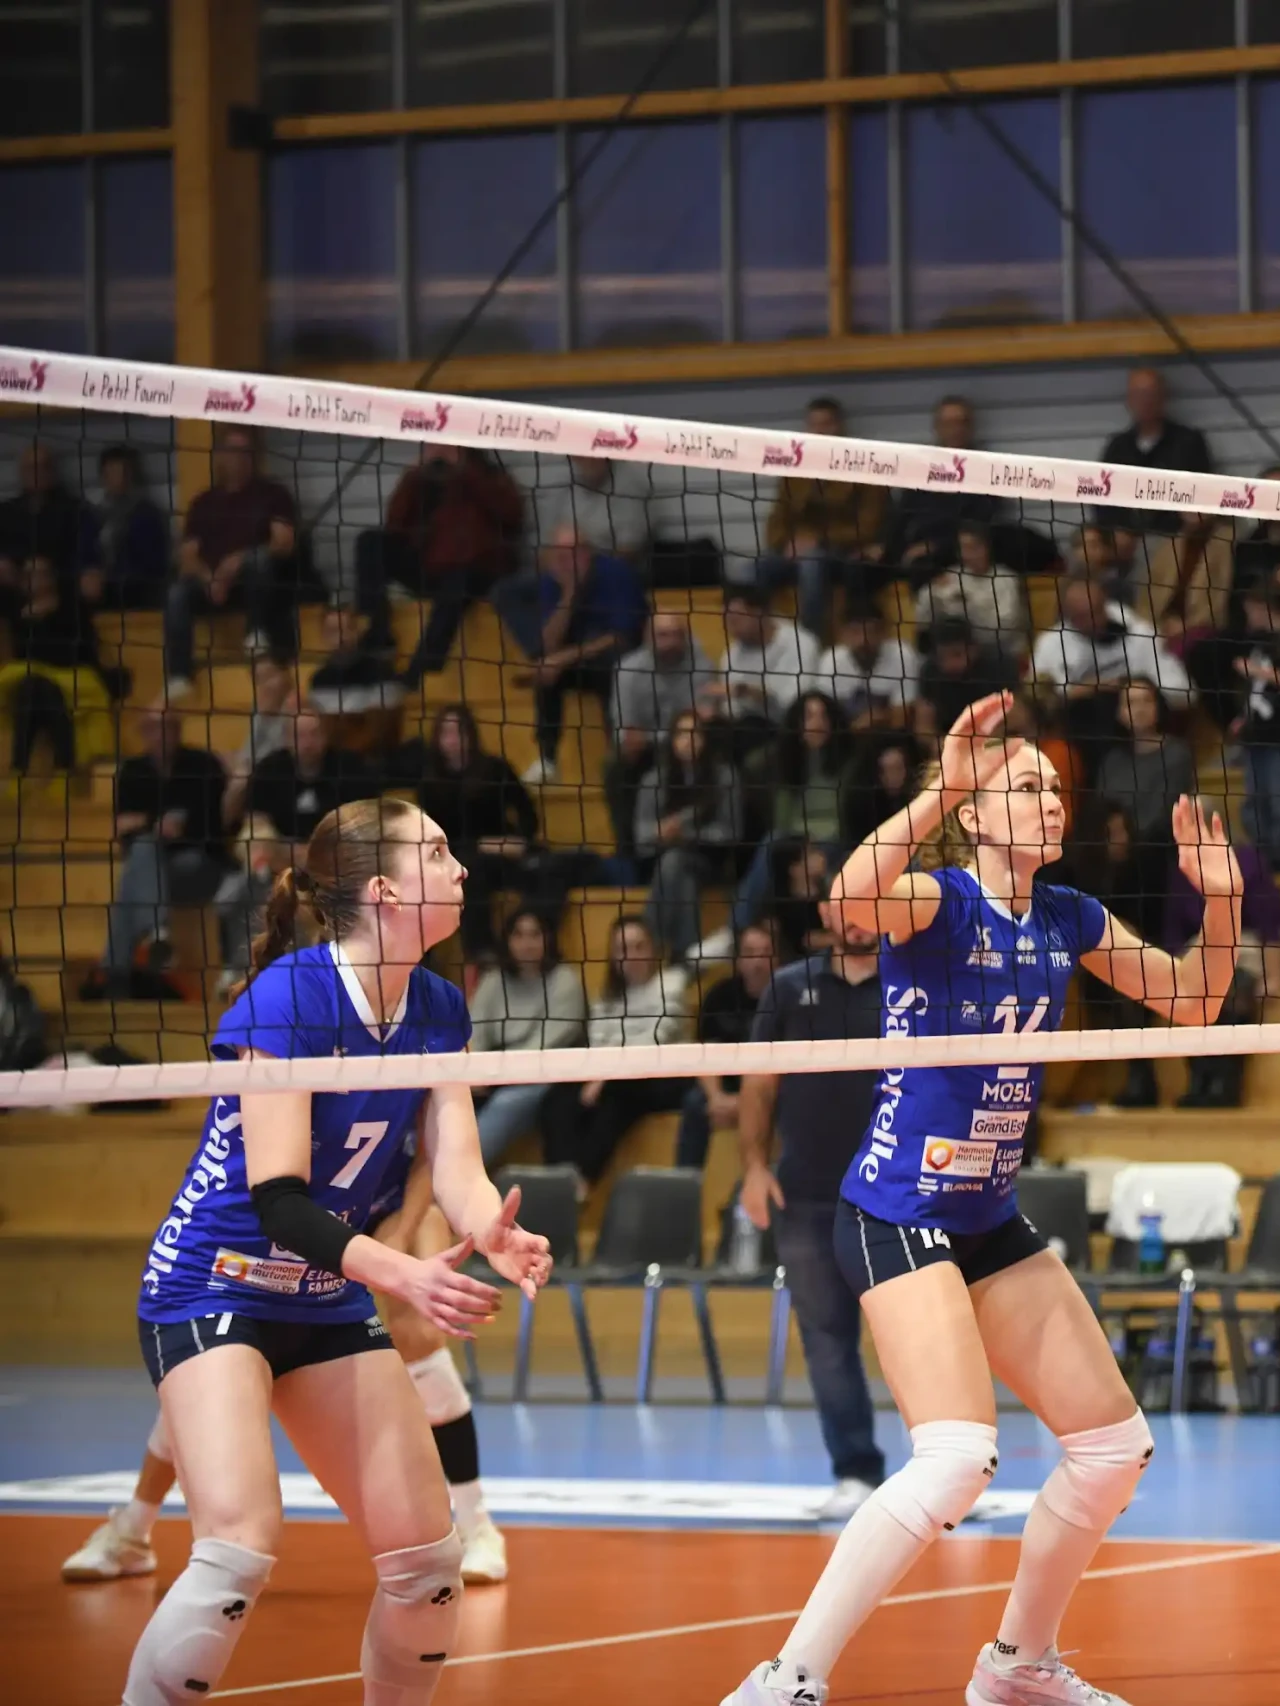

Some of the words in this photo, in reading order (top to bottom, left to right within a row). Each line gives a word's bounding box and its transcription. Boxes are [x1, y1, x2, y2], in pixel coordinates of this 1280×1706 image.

[82, 372, 96, 398] Le
[101, 374, 129, 401] Petit
[135, 377, 175, 405] Fournil
[204, 395, 244, 413] power
[287, 392, 300, 418] Le
[305, 391, 330, 420] Petit
[335, 398, 372, 424] Fournil
[400, 416, 436, 432] power
[828, 448, 840, 471] Le
[842, 449, 866, 472] Petit
[868, 452, 899, 477] Fournil
[926, 470, 957, 483] power
[990, 464, 1000, 486] Le
[1002, 465, 1025, 487] Petit
[1027, 467, 1055, 490] Fournil
[1076, 484, 1103, 497] power
[1134, 478, 1144, 499] Le
[1146, 479, 1167, 502] Petit
[1168, 480, 1196, 505] Fournil
[1220, 498, 1247, 510] power
[329, 1121, 389, 1189] 7
[955, 1154, 992, 1162] mutuelle
[957, 1145, 994, 1155] Harmonie
[251, 1269, 300, 1282] mutuelle
[255, 1262, 303, 1274] Harmonie
